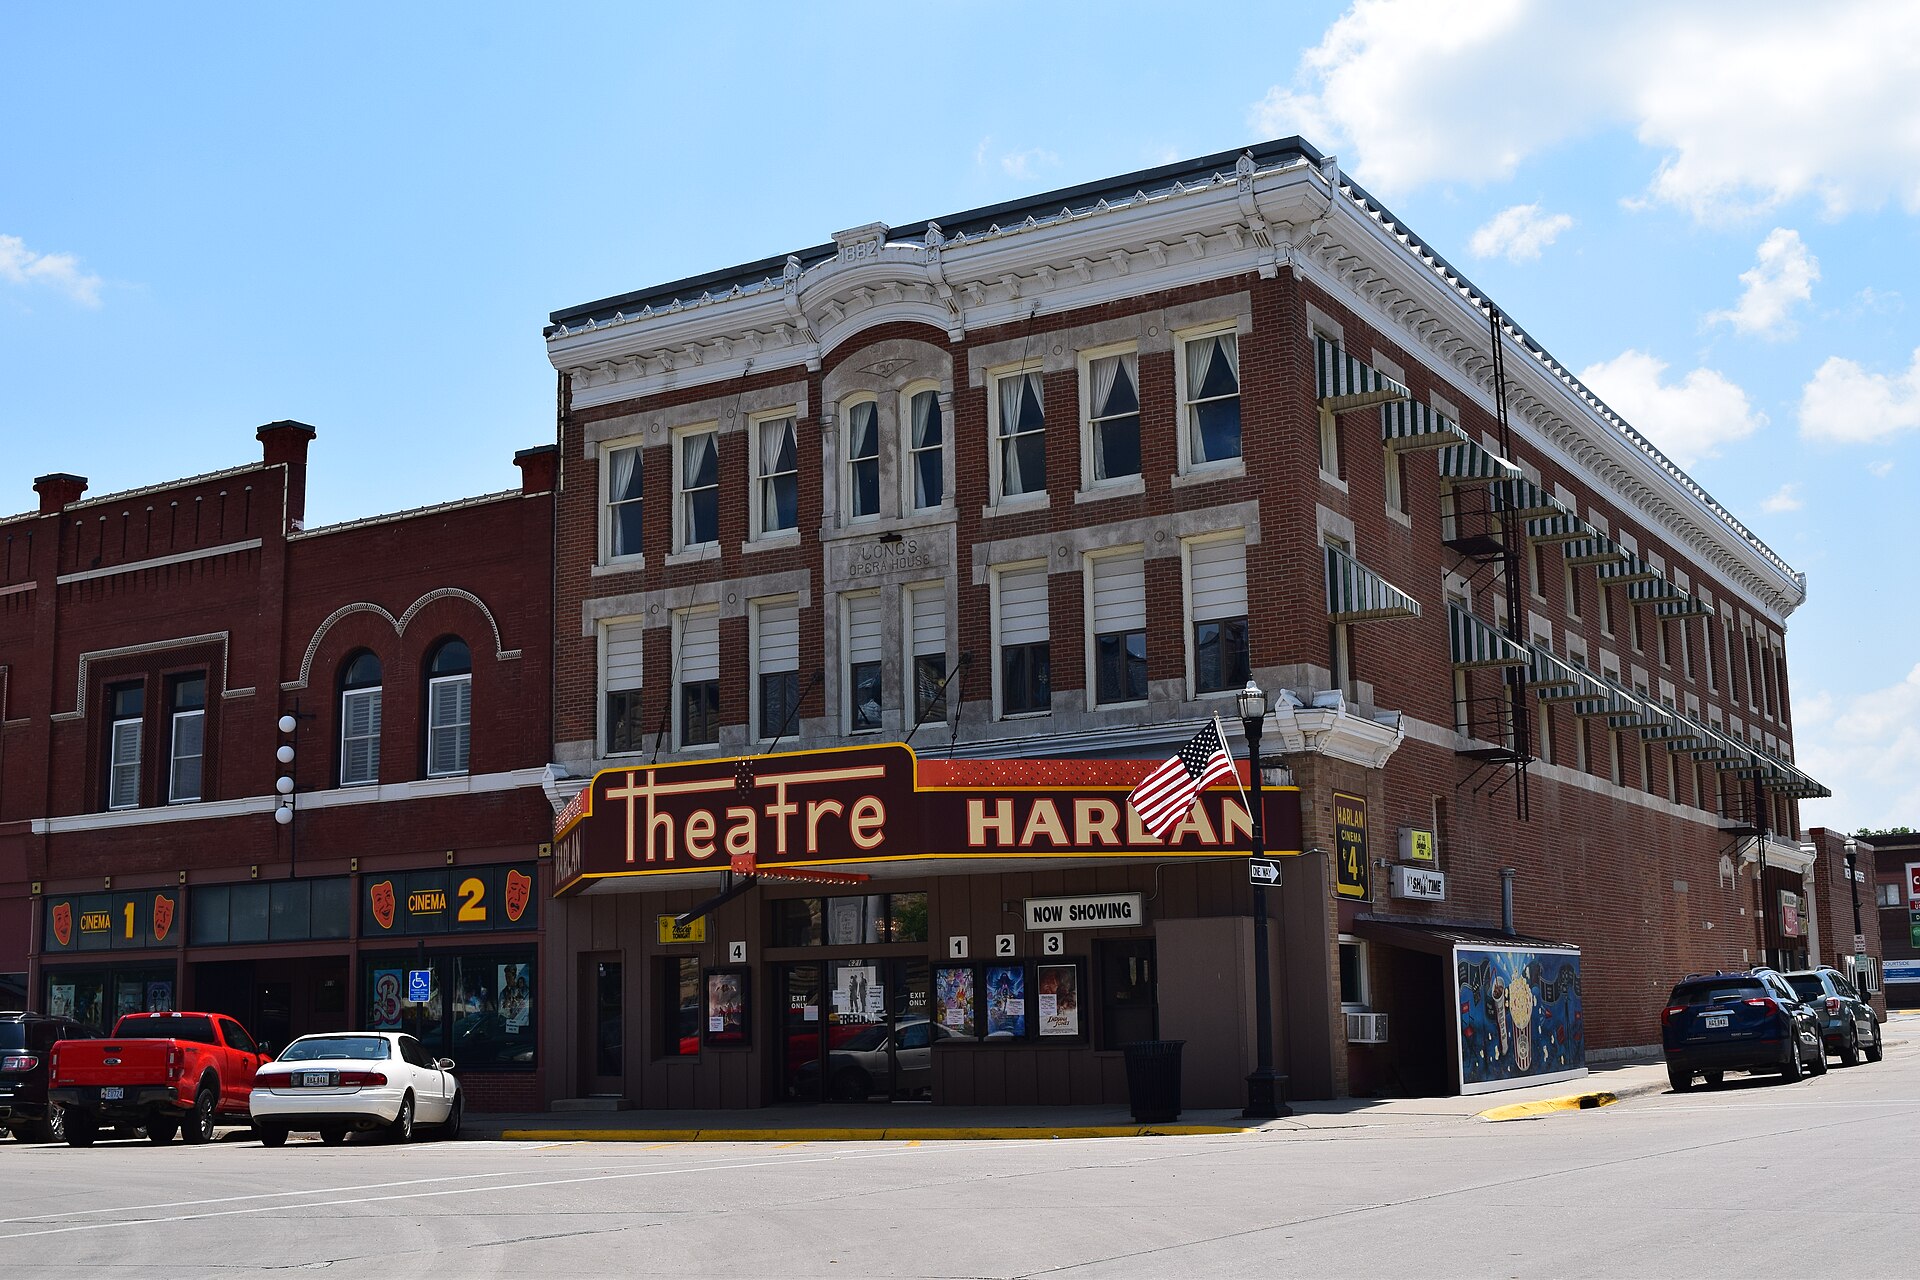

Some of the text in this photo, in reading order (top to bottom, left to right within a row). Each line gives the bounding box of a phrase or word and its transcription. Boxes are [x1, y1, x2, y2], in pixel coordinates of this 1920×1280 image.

[840, 240, 878, 264] 1882
[849, 554, 930, 576] OPERA HOUSE
[966, 797, 1266, 847] HARLAN
[1337, 806, 1364, 829] HARLAN
[1341, 829, 1362, 844] CINEMA
[555, 828, 581, 887] HARLAN
[1347, 846, 1358, 880] 4
[1252, 866, 1261, 876] ONE
[408, 877, 486, 922] CINEMA 2
[80, 902, 135, 938] CINEMA 1
[1033, 901, 1131, 922] NOW SHOWING
[733, 945, 741, 958] 4
[954, 940, 962, 954] 1
[1000, 938, 1011, 952] 2
[1048, 936, 1059, 952] 3
